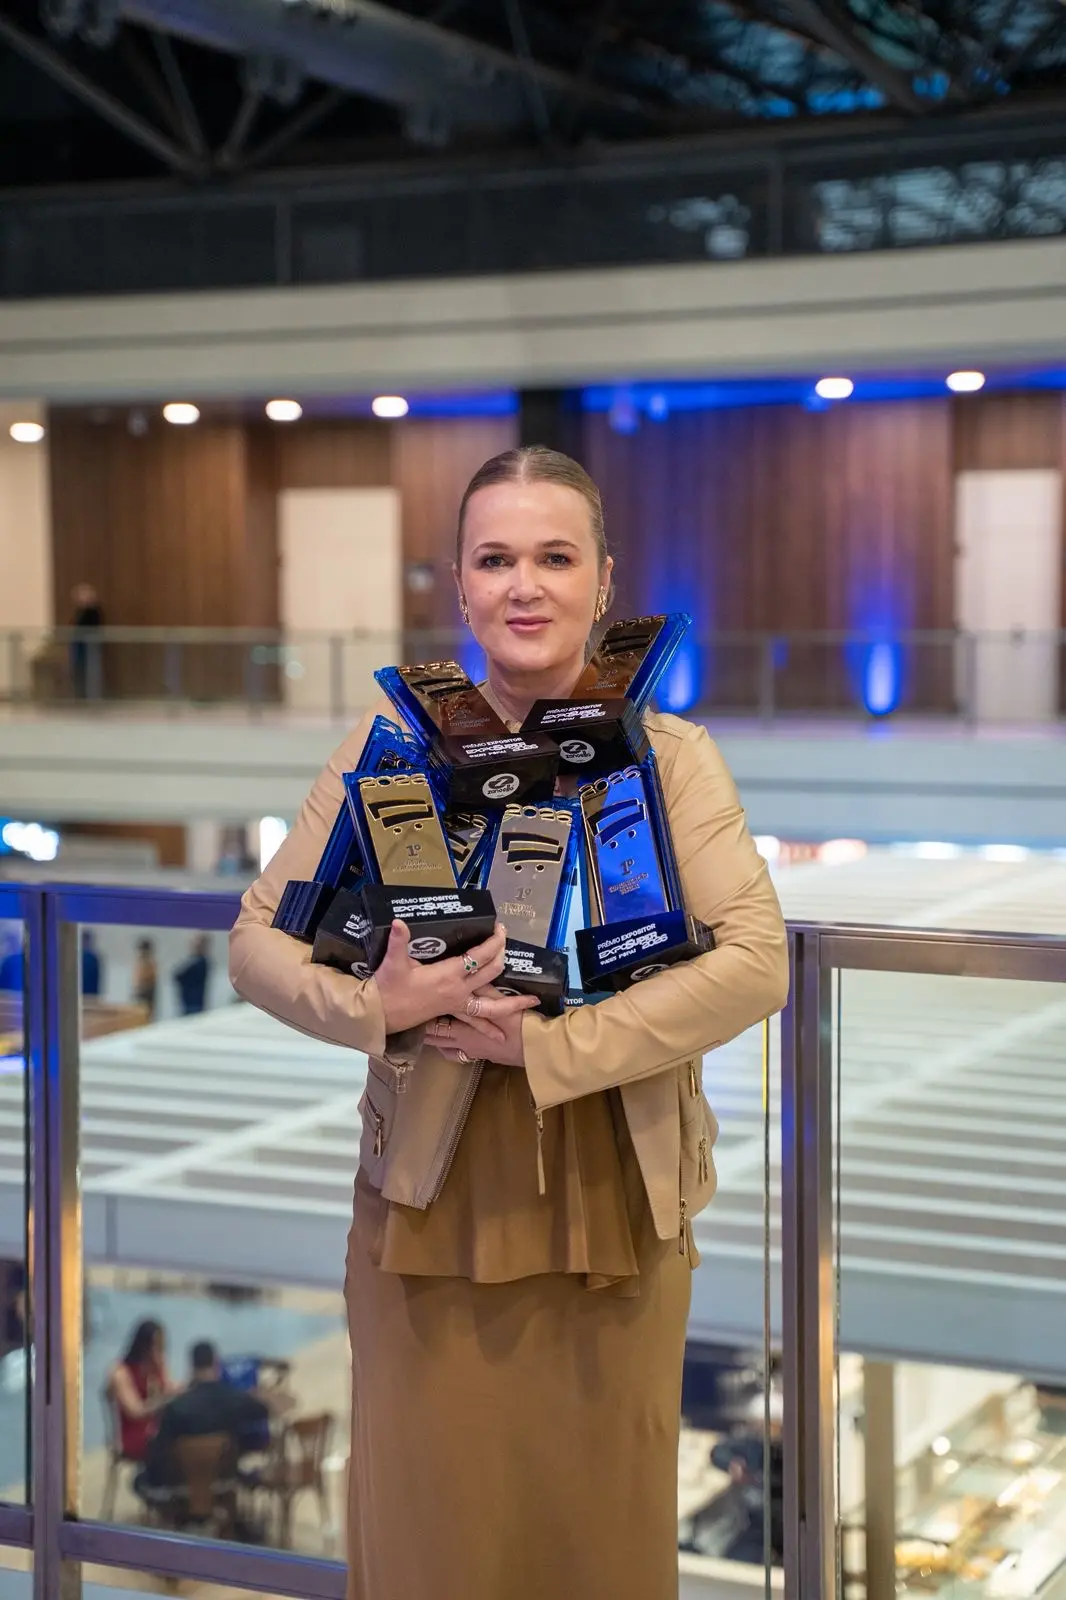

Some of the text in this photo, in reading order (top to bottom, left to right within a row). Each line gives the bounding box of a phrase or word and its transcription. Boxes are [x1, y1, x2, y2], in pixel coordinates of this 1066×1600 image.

[568, 704, 603, 712] EXPOSITOR
[580, 711, 606, 719] 2026
[487, 737, 523, 746] EXPOSITOR
[512, 743, 539, 752] 2026
[419, 895, 460, 903] EXPOSITOR
[443, 905, 474, 914] 2026
[597, 923, 657, 950] PRÊMIO EXPOSITOR
[641, 933, 669, 950] 2026
[505, 949, 535, 959] POSITOR
[512, 965, 543, 975] 2026
